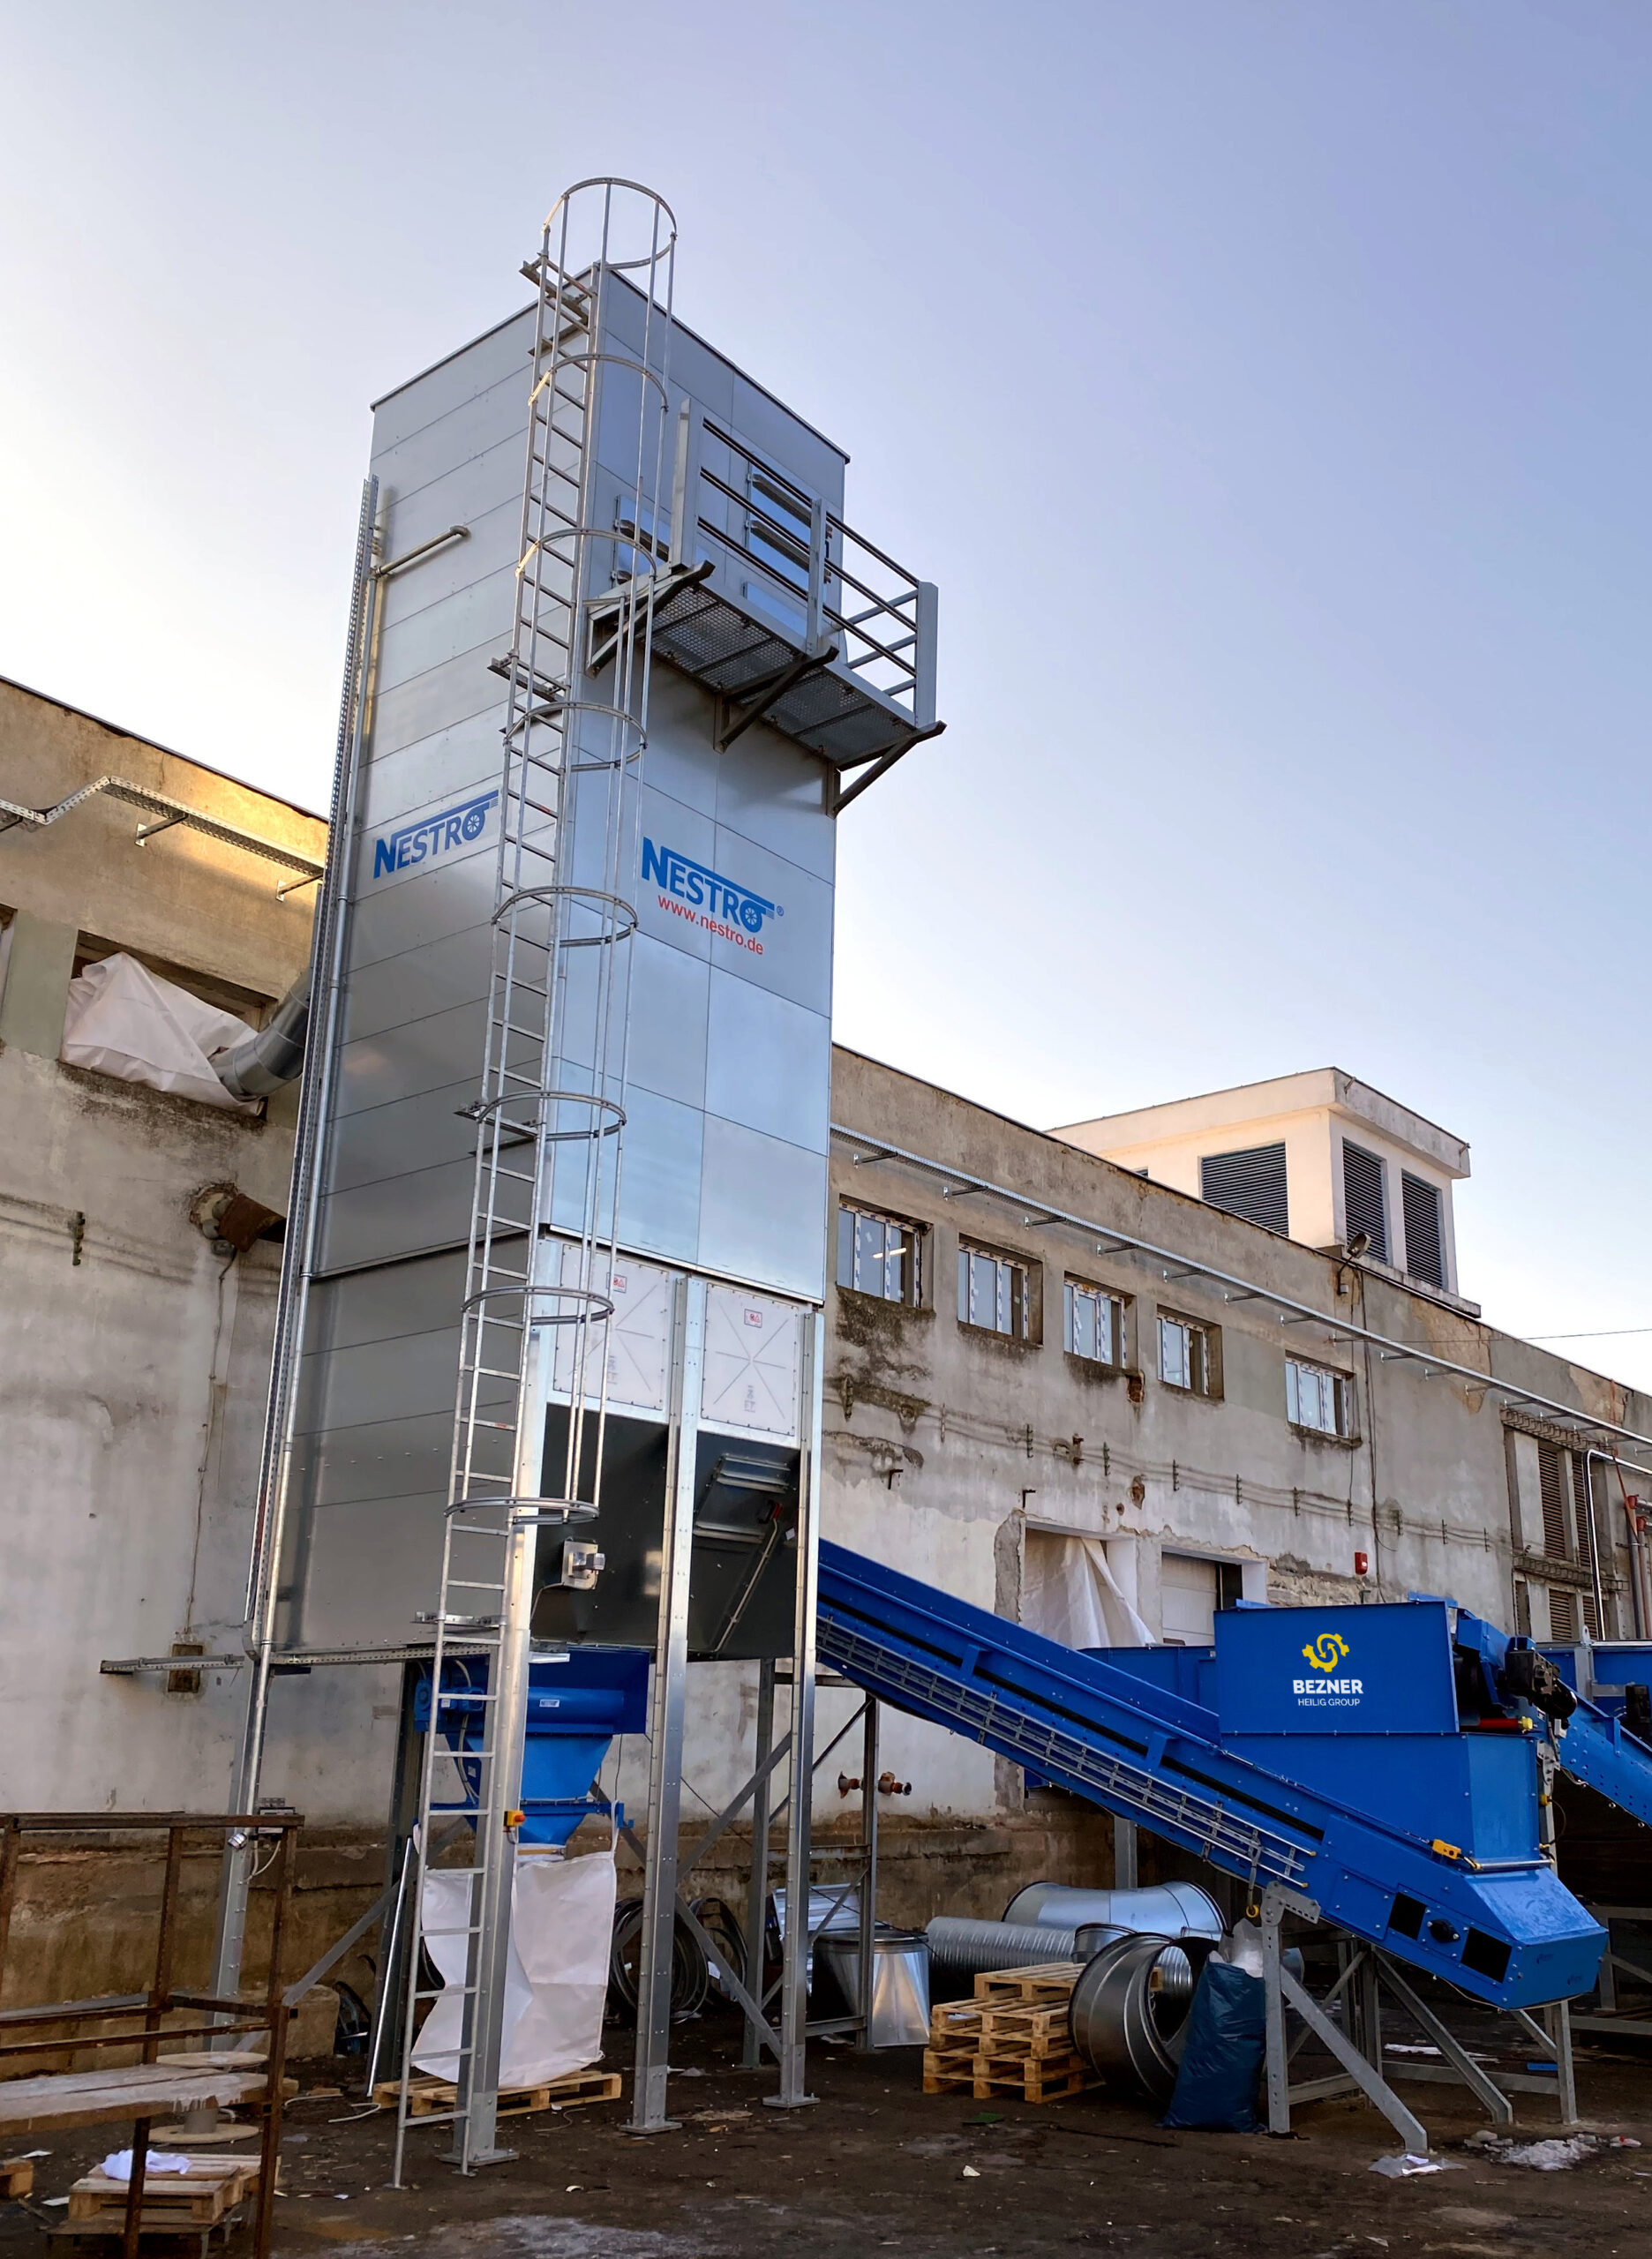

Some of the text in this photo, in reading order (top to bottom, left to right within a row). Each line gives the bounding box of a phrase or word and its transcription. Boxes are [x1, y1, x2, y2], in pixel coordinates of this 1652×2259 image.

[373, 790, 499, 879] NESTRO
[657, 894, 764, 955] www.nestro.de
[1293, 1679, 1363, 1694] BEZNER
[1297, 1698, 1360, 1707] HEILIG GROUP
